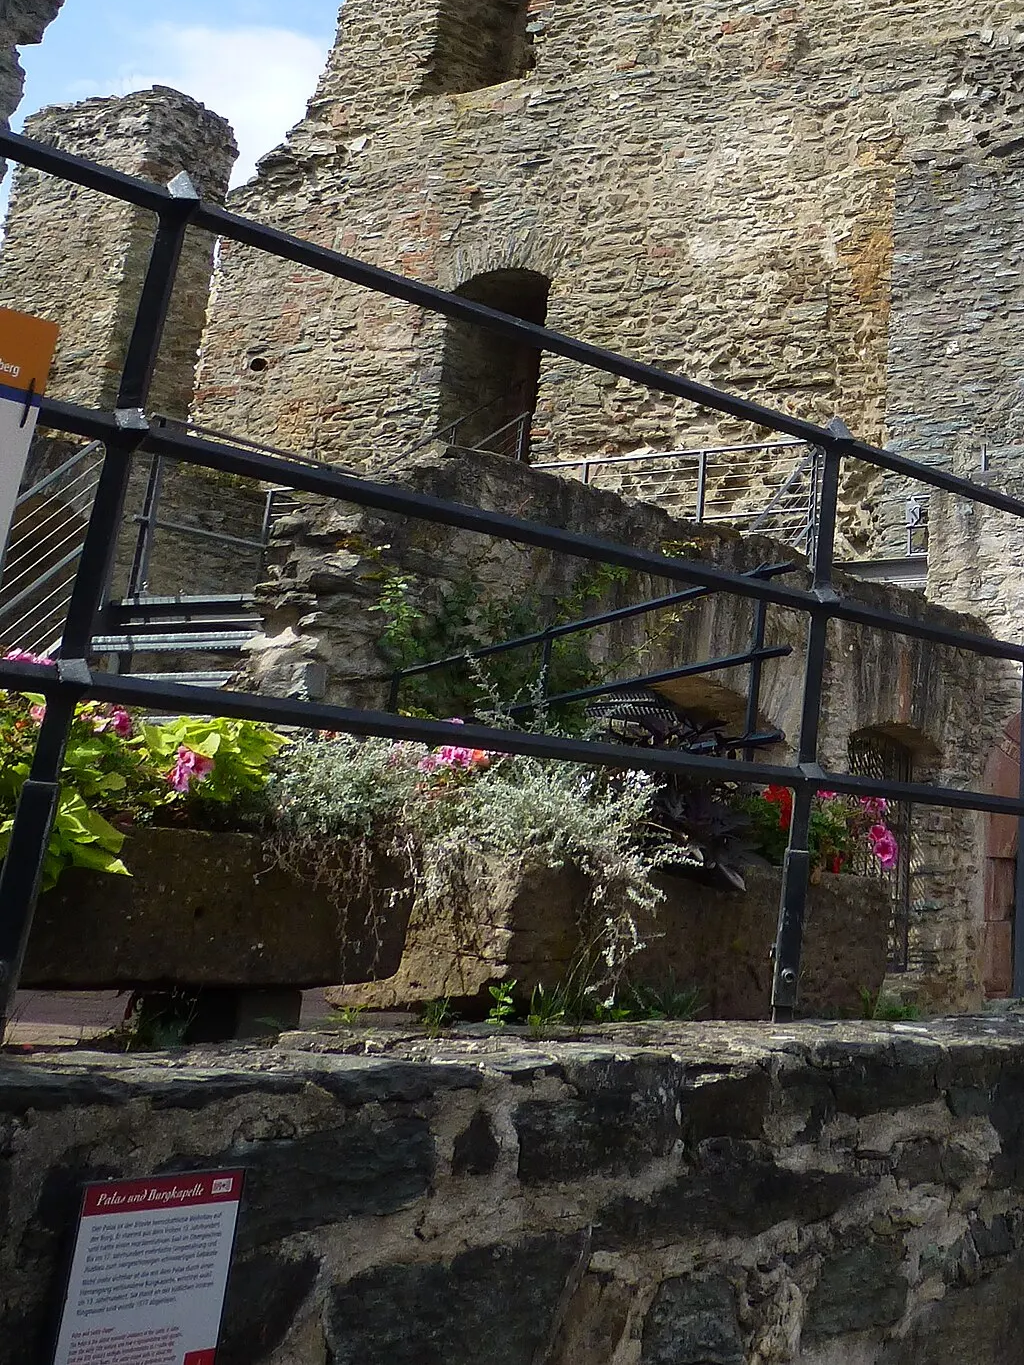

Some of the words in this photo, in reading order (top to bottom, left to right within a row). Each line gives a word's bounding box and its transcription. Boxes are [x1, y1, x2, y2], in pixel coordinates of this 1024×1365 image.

[96, 1192, 126, 1206] Palas
[127, 1189, 148, 1202] und
[148, 1183, 204, 1202] Burgkapelle
